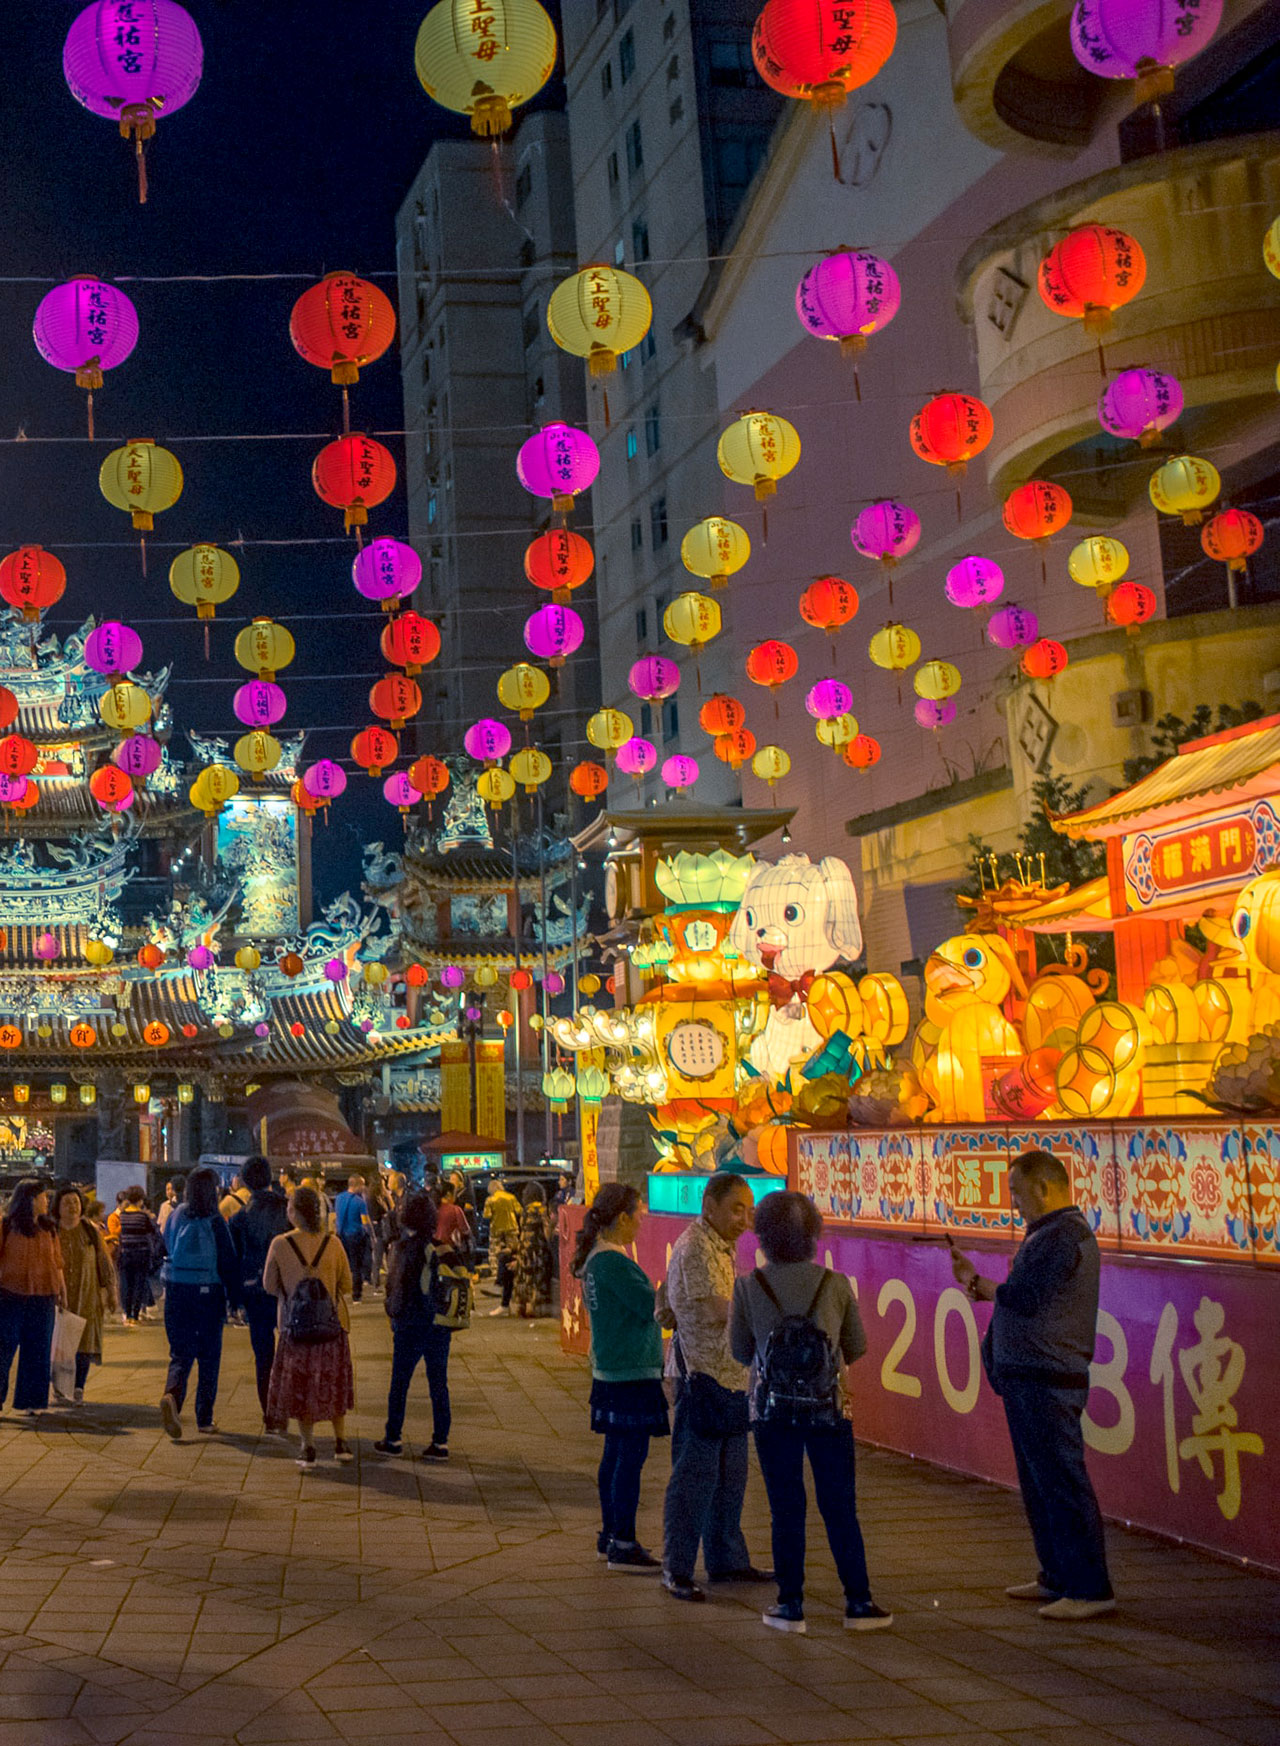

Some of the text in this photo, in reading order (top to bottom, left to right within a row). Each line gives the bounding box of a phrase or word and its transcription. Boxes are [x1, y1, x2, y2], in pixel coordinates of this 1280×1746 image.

[113, 3, 144, 75] 慈祐宮
[341, 289, 361, 341] 慈祐宮
[591, 271, 613, 331] 天上聖母
[862, 261, 883, 316] 慈祐宮
[86, 292, 109, 346] 慈祐宮
[960, 395, 979, 446] 天上聖母
[125, 447, 144, 497] 天上聖母
[356, 439, 375, 490] 天上聖母
[1162, 827, 1242, 880] 福滿門
[957, 1158, 1008, 1206] 添丁
[876, 1278, 1135, 1455] 208
